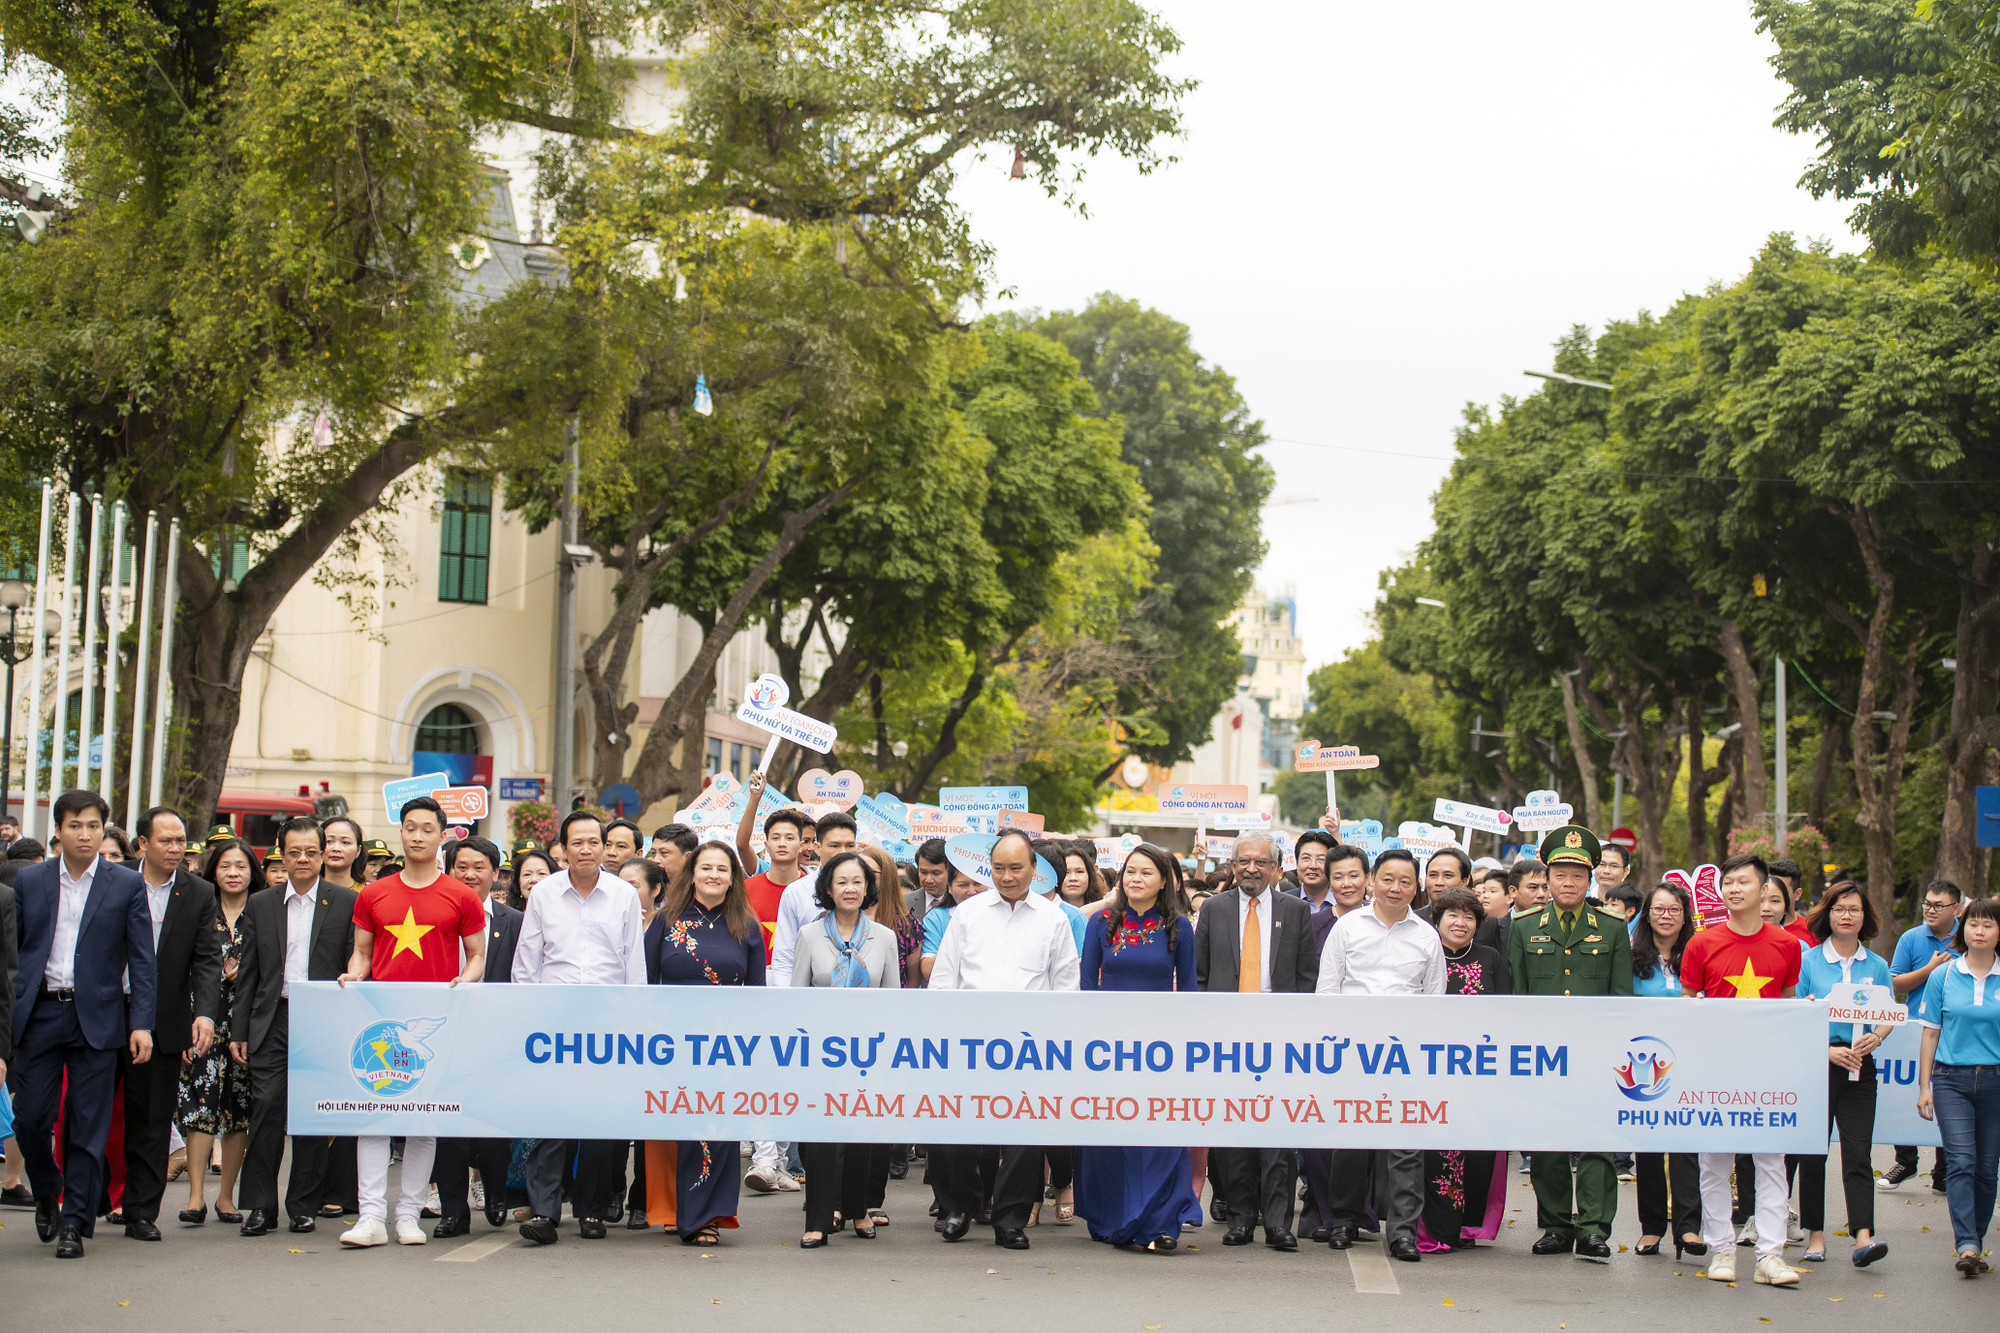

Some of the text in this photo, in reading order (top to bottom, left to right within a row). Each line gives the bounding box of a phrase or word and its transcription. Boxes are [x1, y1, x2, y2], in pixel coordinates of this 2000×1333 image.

[743, 709, 764, 724] PHỤ
[781, 722, 793, 734] VÀ
[795, 728, 813, 742] TRẺ
[813, 737, 828, 748] EM
[775, 711, 788, 721] AN
[813, 726, 833, 738] CHO
[860, 800, 875, 812] MUA
[912, 824, 948, 833] TRƯỜNG
[949, 826, 968, 834] HỌC
[1853, 1009, 1869, 1020] IM
[525, 1028, 1568, 1082] CHUNG TAY VÌ SỰ AN TOÀN CHO PHỤ NỮ VÀ TRẺ EM
[369, 1071, 410, 1081] VIETNAM
[1678, 1089, 1798, 1105] AN TOÀN CHO
[318, 1101, 460, 1114] HỘI LIÊN HIỆP PHỤ NỮ VIỆT NAM
[644, 1086, 725, 1115] NĂM
[733, 1091, 800, 1116] 2019
[824, 1088, 905, 1118] NĂM
[913, 1094, 963, 1119] AN
[970, 1090, 1063, 1120] TOÀN
[1070, 1096, 1140, 1121] CHO
[1147, 1097, 1216, 1126] PHỤ
[1223, 1095, 1275, 1123] NỮ
[1280, 1095, 1327, 1123] VÀ
[1333, 1093, 1393, 1124] TRẺ
[1400, 1100, 1449, 1124] EM
[1617, 1107, 1797, 1130] PHỤ NỮ VÀ TRẺ EM
